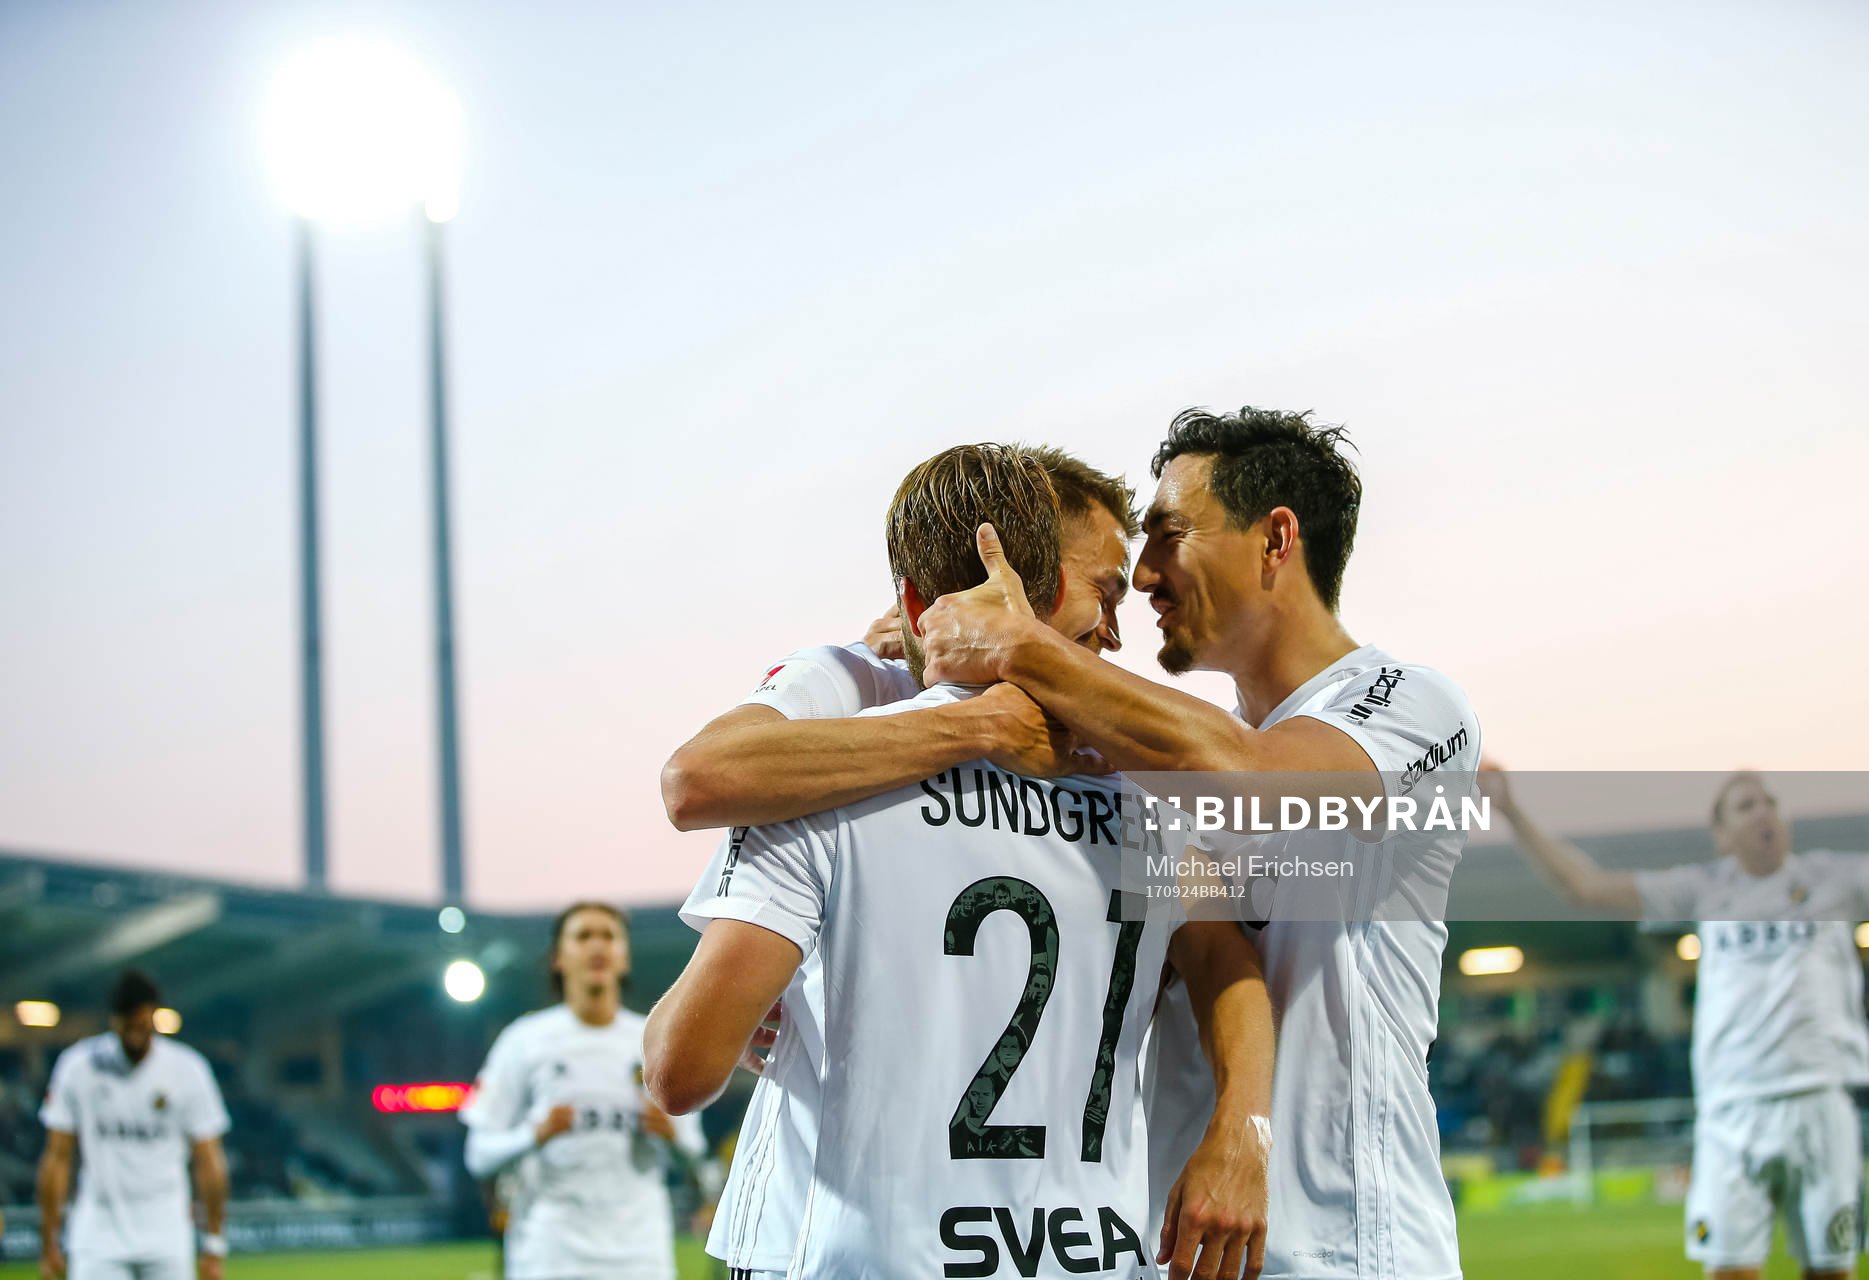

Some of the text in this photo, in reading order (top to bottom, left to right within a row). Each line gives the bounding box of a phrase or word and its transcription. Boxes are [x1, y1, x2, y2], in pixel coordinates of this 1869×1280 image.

[1400, 728, 1468, 796] stadium
[920, 767, 1164, 854] SUNDGREN
[938, 1205, 1148, 1278] SVEA
